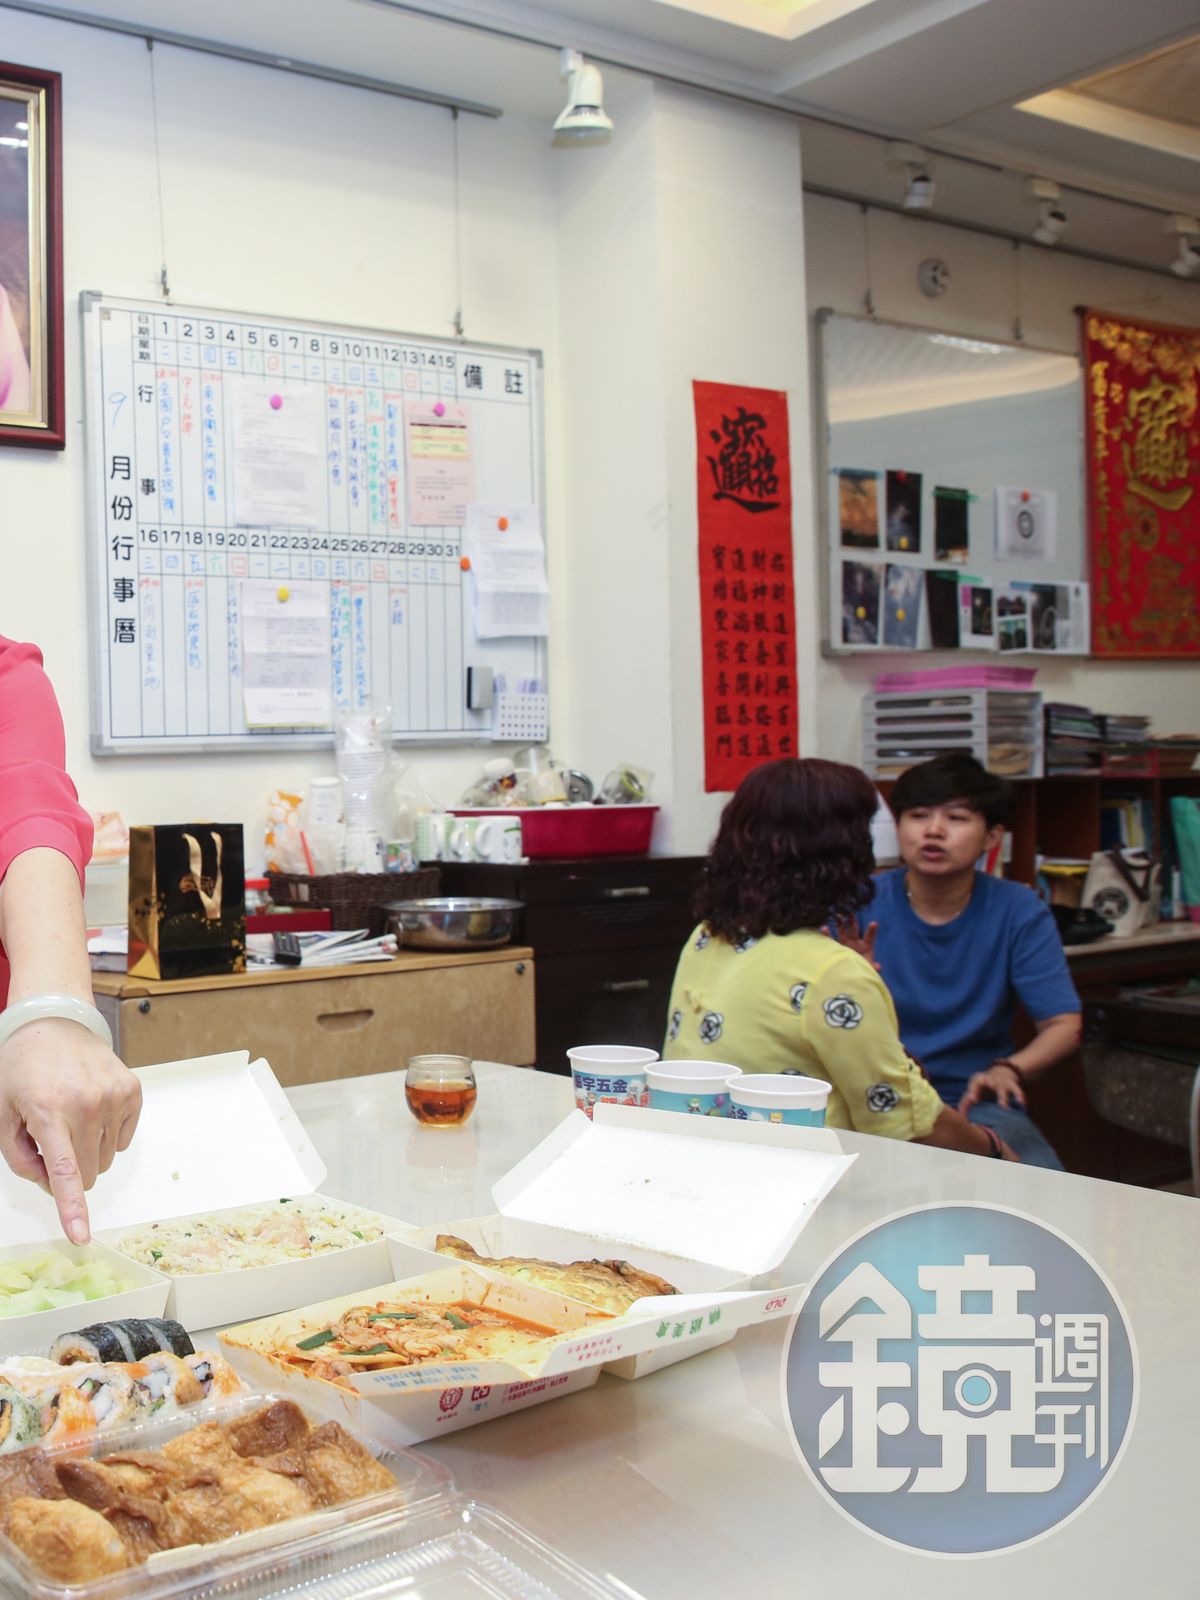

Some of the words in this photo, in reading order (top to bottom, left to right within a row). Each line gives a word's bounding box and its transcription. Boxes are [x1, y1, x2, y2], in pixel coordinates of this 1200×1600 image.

[163, 321, 168, 335] 1
[184, 324, 193, 338] 2
[205, 326, 215, 339] 3
[226, 329, 235, 342] 4
[248, 331, 258, 345] 5
[269, 334, 279, 347] 6
[289, 336, 298, 349] 7
[310, 339, 320, 352] 8
[330, 341, 339, 354] 9
[345, 343, 362, 357] 10
[365, 345, 380, 359] 11
[384, 348, 400, 362] 12
[403, 351, 419, 364] 13
[421, 353, 437, 366] 14
[440, 355, 455, 368] 15
[110, 455, 136, 645] 月份行事曆
[140, 529, 159, 543] 16
[163, 530, 181, 544] 17
[185, 531, 203, 545] 18
[207, 532, 225, 546] 19
[228, 533, 247, 547] 20
[251, 534, 267, 547] 21
[271, 535, 289, 549] 22
[291, 536, 310, 550] 23
[311, 537, 329, 550] 24
[331, 538, 349, 551] 25
[351, 539, 369, 553] 26
[371, 540, 388, 553] 27
[389, 541, 406, 554] 28
[408, 542, 425, 555] 29
[426, 543, 443, 556] 30
[445, 545, 460, 557] 31
